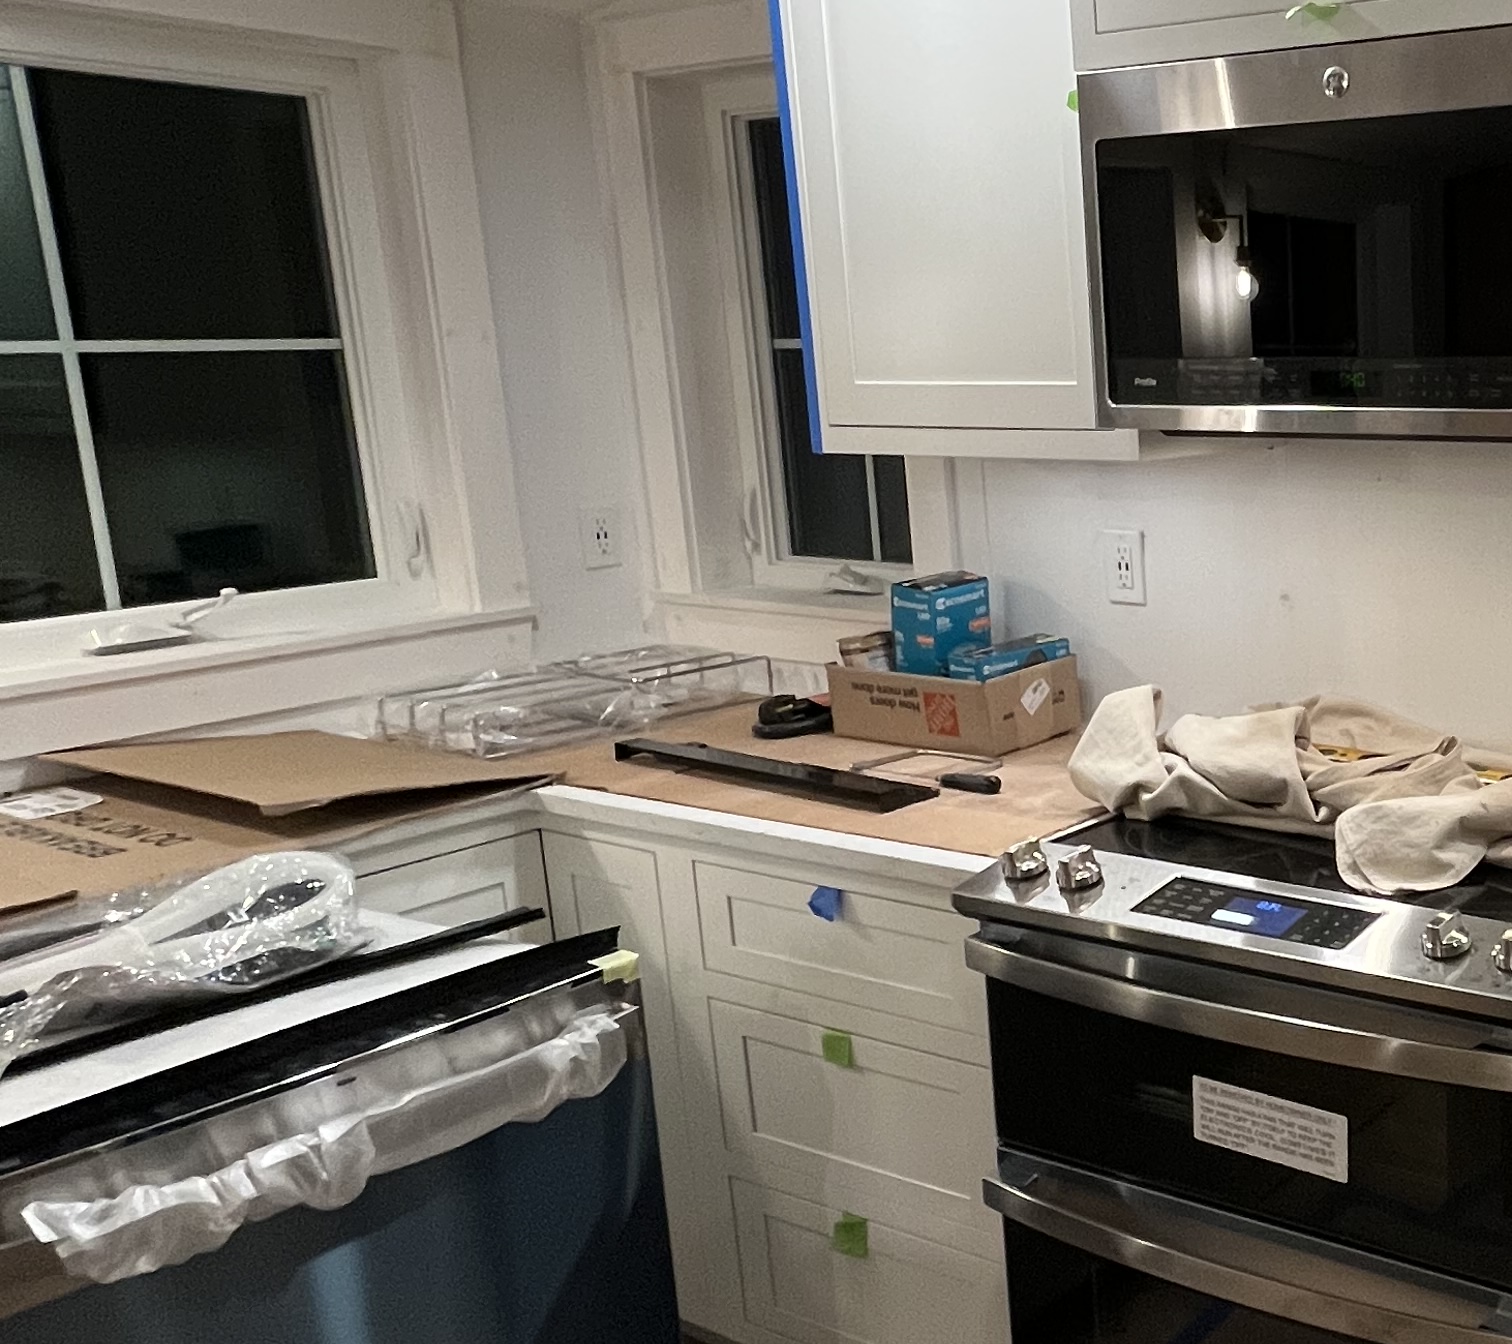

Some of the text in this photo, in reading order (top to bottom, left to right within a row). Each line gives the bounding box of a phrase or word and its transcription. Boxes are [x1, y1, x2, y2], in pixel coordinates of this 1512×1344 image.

[877, 683, 901, 696] more
[903, 687, 918, 698] get
[869, 695, 920, 713] How doers
